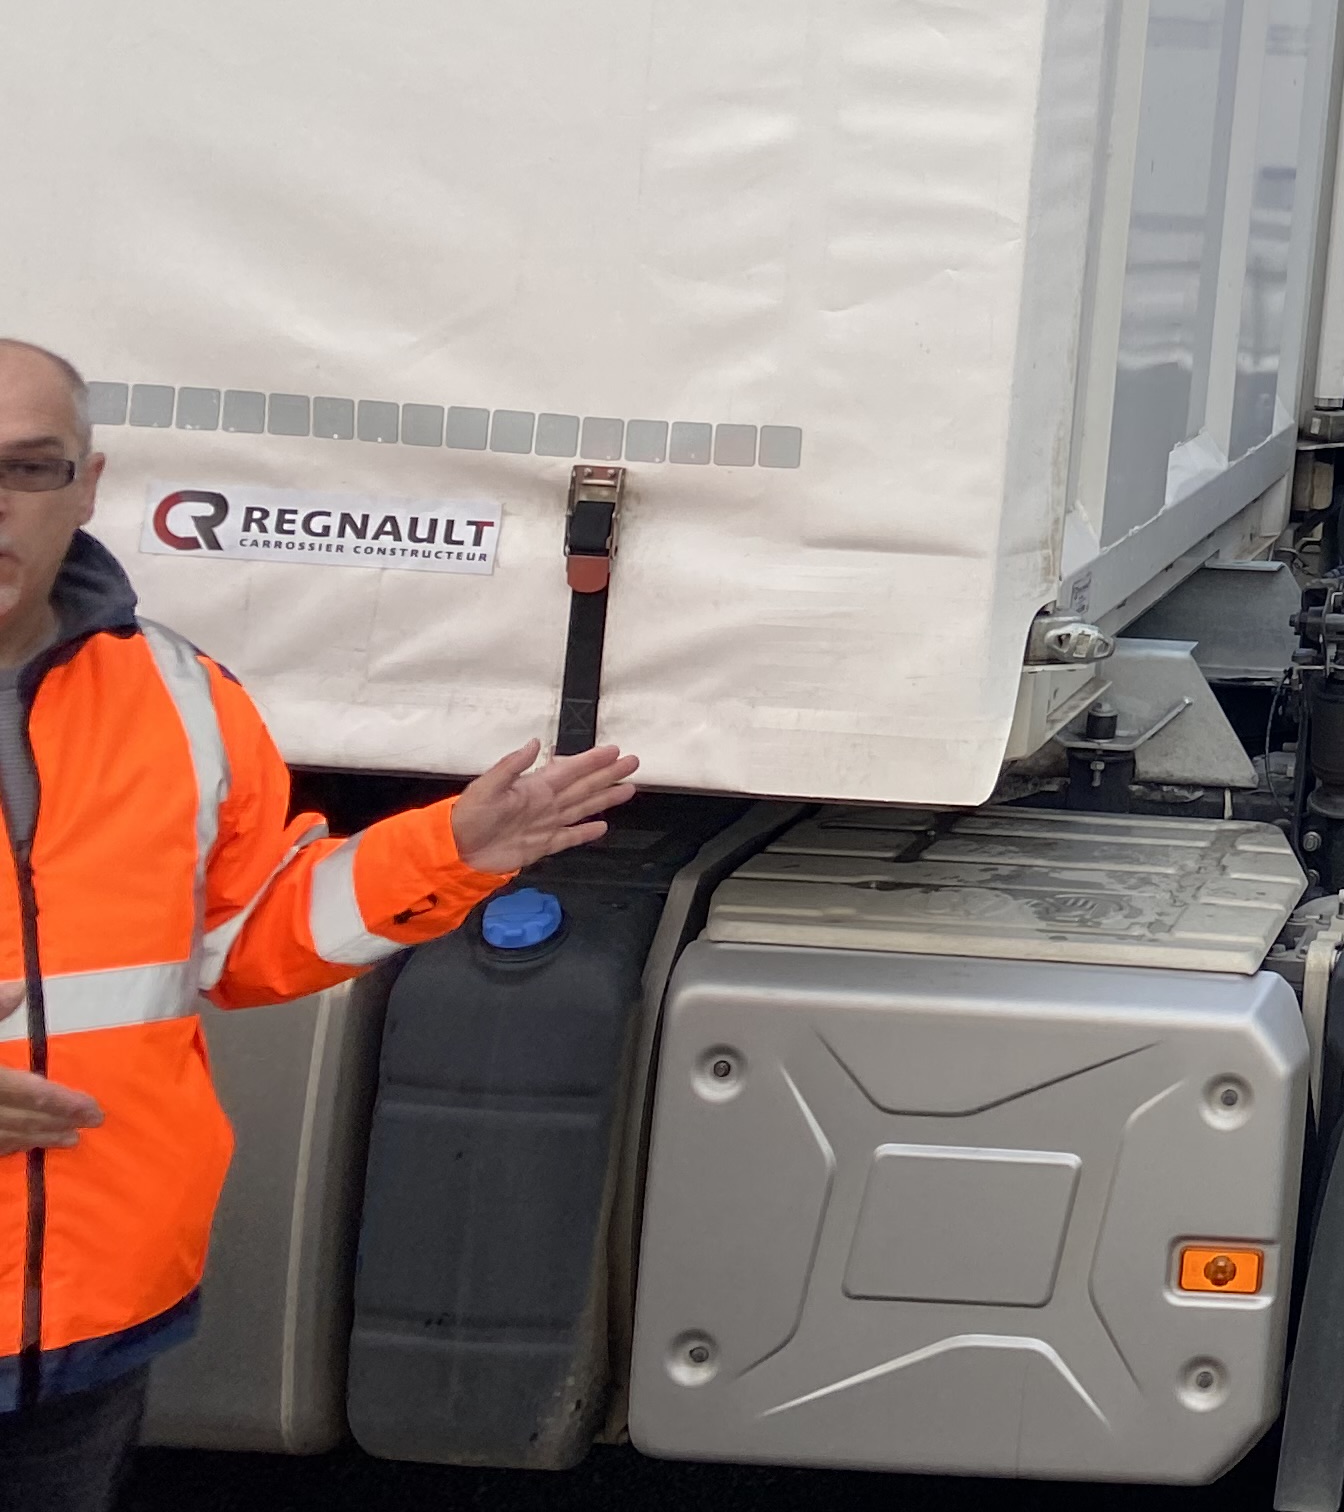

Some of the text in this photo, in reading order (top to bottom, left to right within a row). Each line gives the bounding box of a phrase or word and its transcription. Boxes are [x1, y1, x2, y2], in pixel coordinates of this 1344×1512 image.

[241, 506, 494, 547] REGNAULT
[239, 538, 487, 563] CARROSSIER CONSTRUCTEUR
